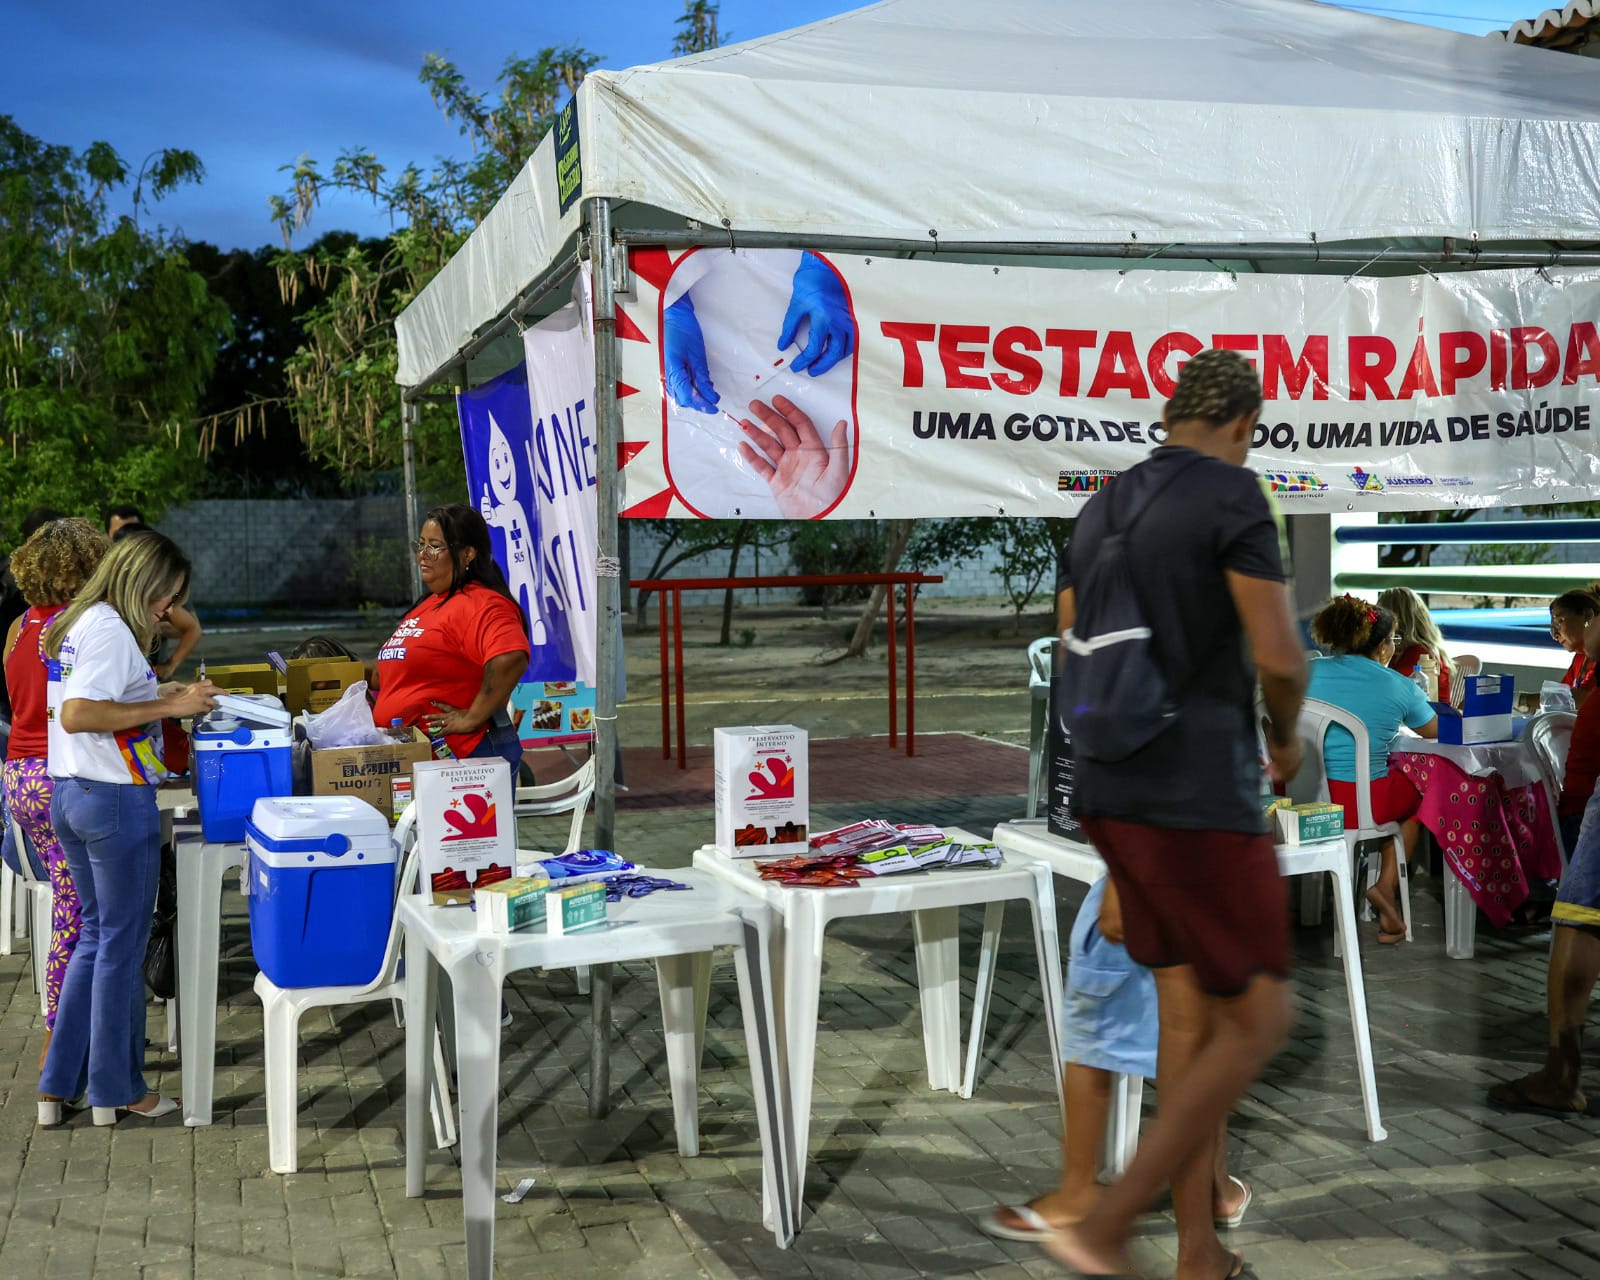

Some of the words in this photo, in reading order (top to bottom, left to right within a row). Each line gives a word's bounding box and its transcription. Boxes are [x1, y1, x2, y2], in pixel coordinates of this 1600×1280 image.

[1348, 316, 1600, 401] RÁPIDA
[912, 411, 996, 440] UMA
[1003, 413, 1100, 442] GOTA
[1100, 420, 1146, 444] DE
[1306, 422, 1372, 449] UMA
[1379, 418, 1442, 447] VIDA
[1446, 414, 1490, 442] DE
[1496, 401, 1590, 438] SAÚDE
[748, 734, 795, 742] PRESERVATIVO
[440, 768, 495, 778] PRESERVATIVO
[450, 775, 486, 783] INTERNO
